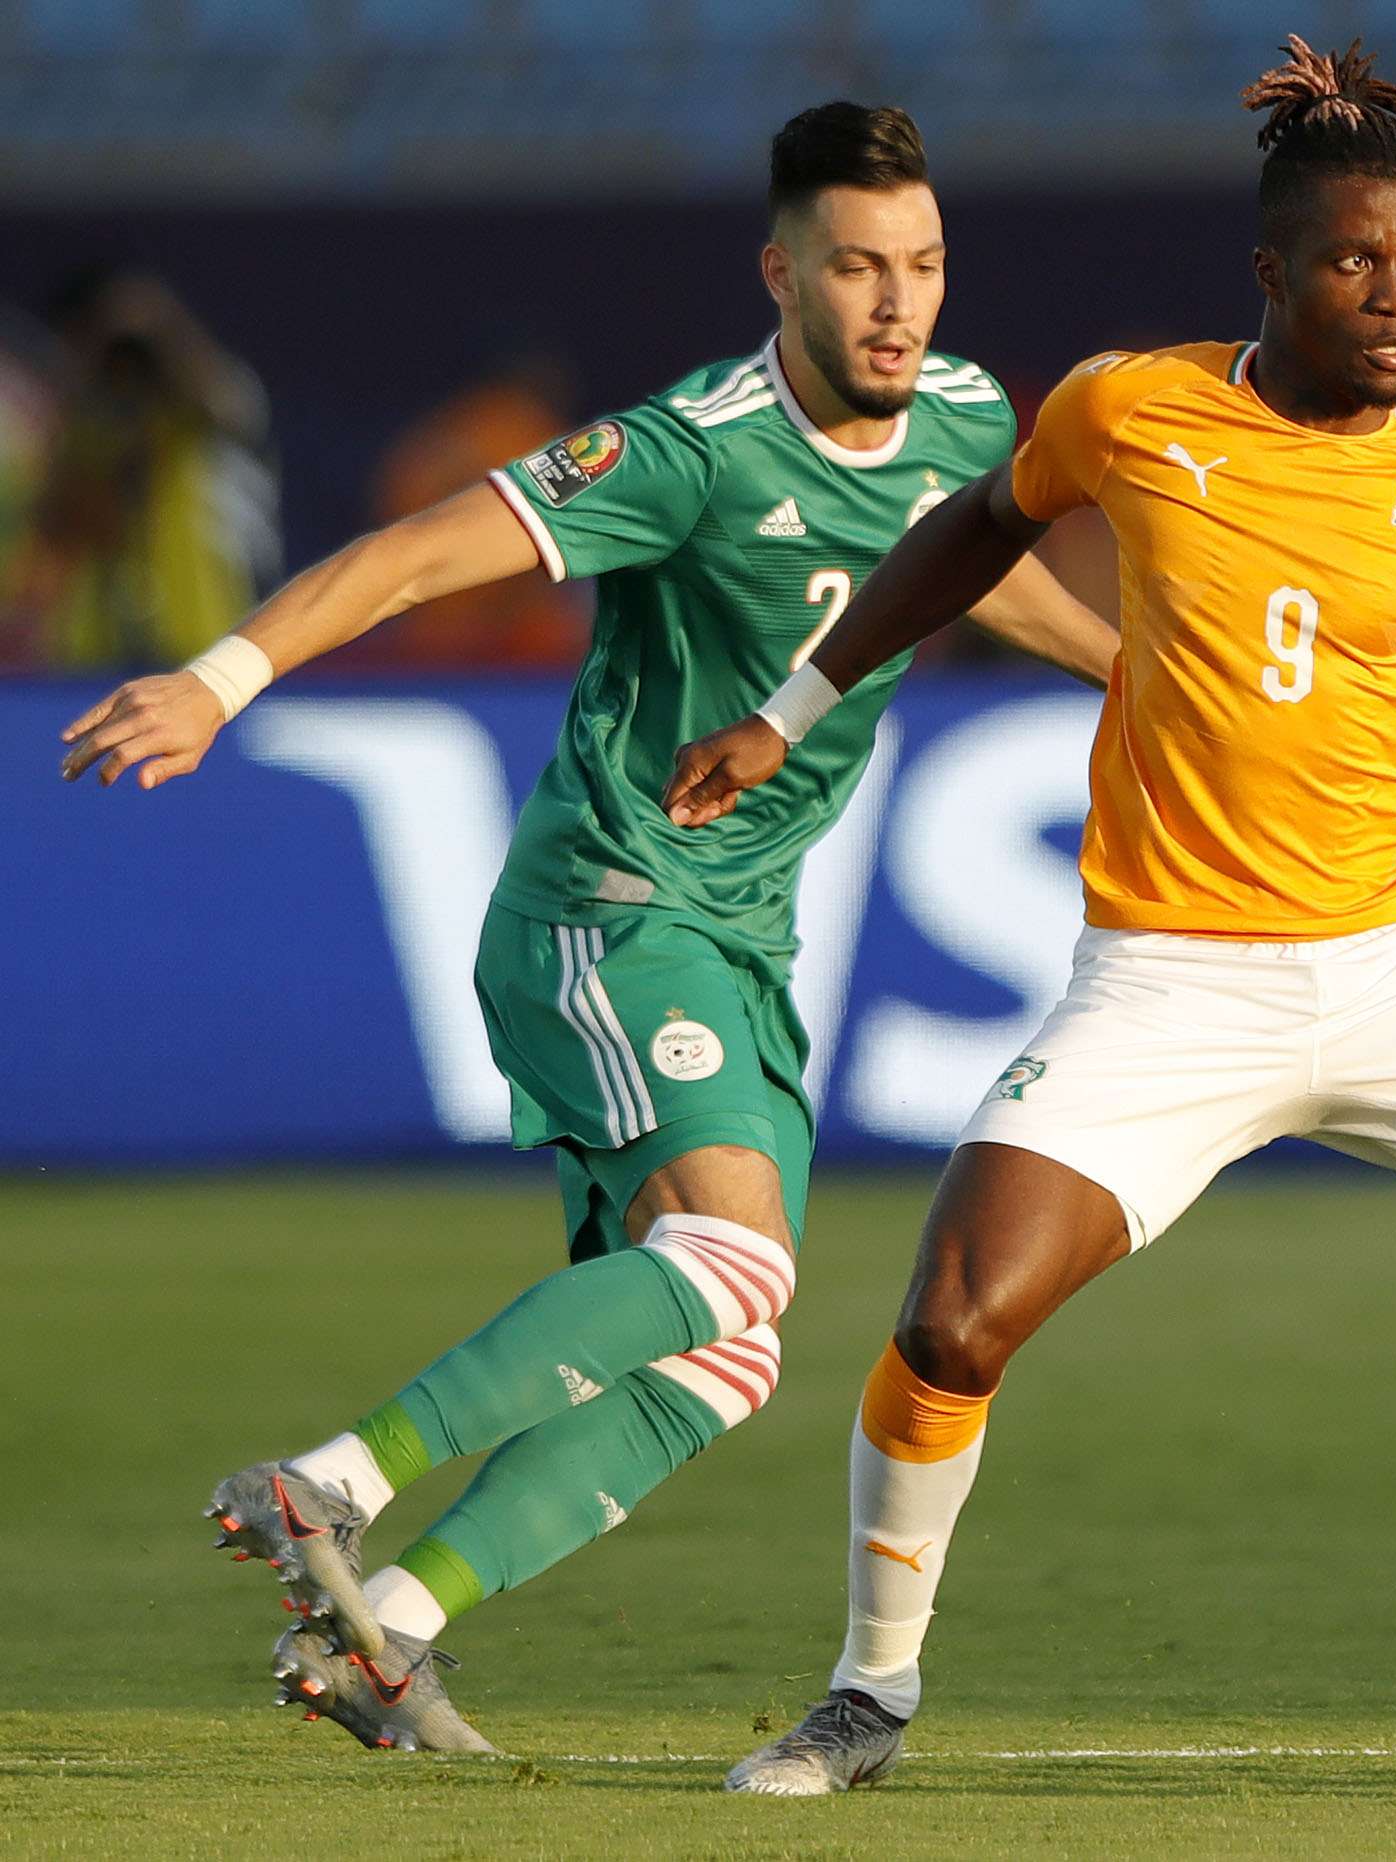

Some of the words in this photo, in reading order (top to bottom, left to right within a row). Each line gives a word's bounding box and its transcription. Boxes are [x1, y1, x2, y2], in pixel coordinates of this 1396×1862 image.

[759, 522, 806, 536] adidas
[789, 568, 851, 673] 2
[1261, 585, 1319, 704] 9
